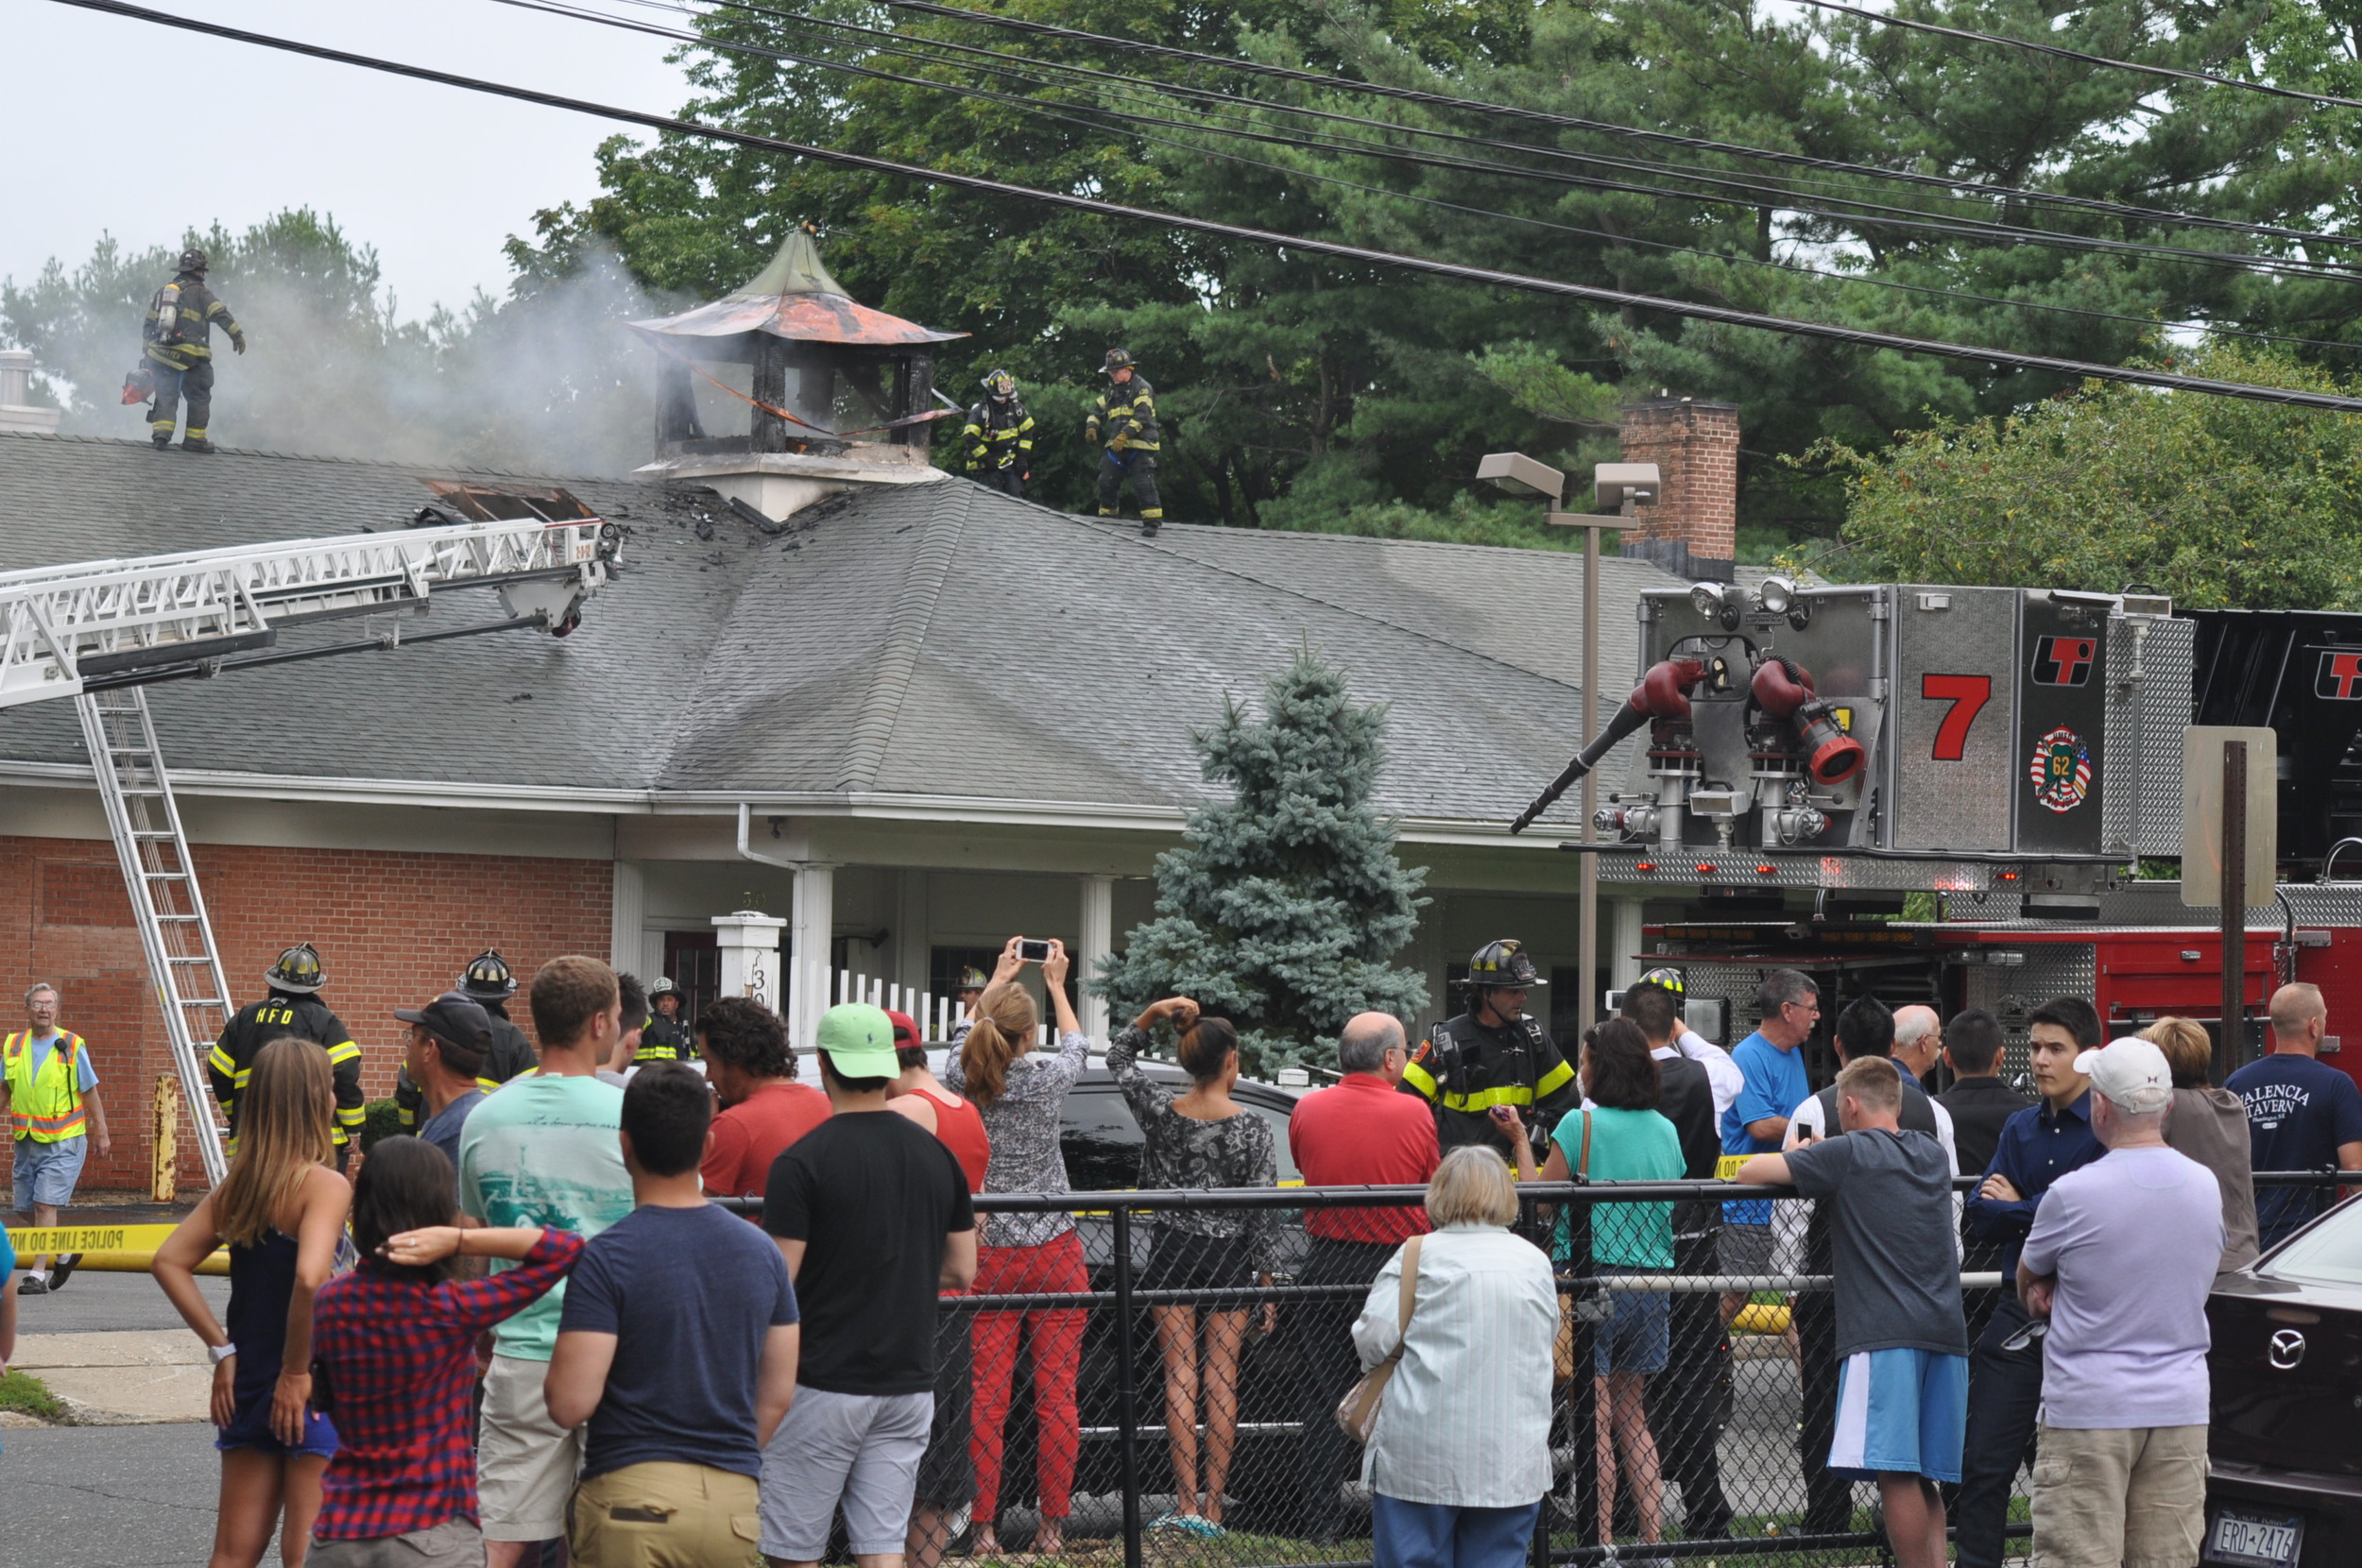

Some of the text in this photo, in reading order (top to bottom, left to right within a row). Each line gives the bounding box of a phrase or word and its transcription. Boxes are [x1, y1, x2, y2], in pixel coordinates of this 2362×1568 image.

[1922, 673, 1991, 761] 7
[2052, 756, 2070, 775] 62
[255, 1007, 294, 1025] HFD
[2244, 1099, 2296, 1118] TAVERN
